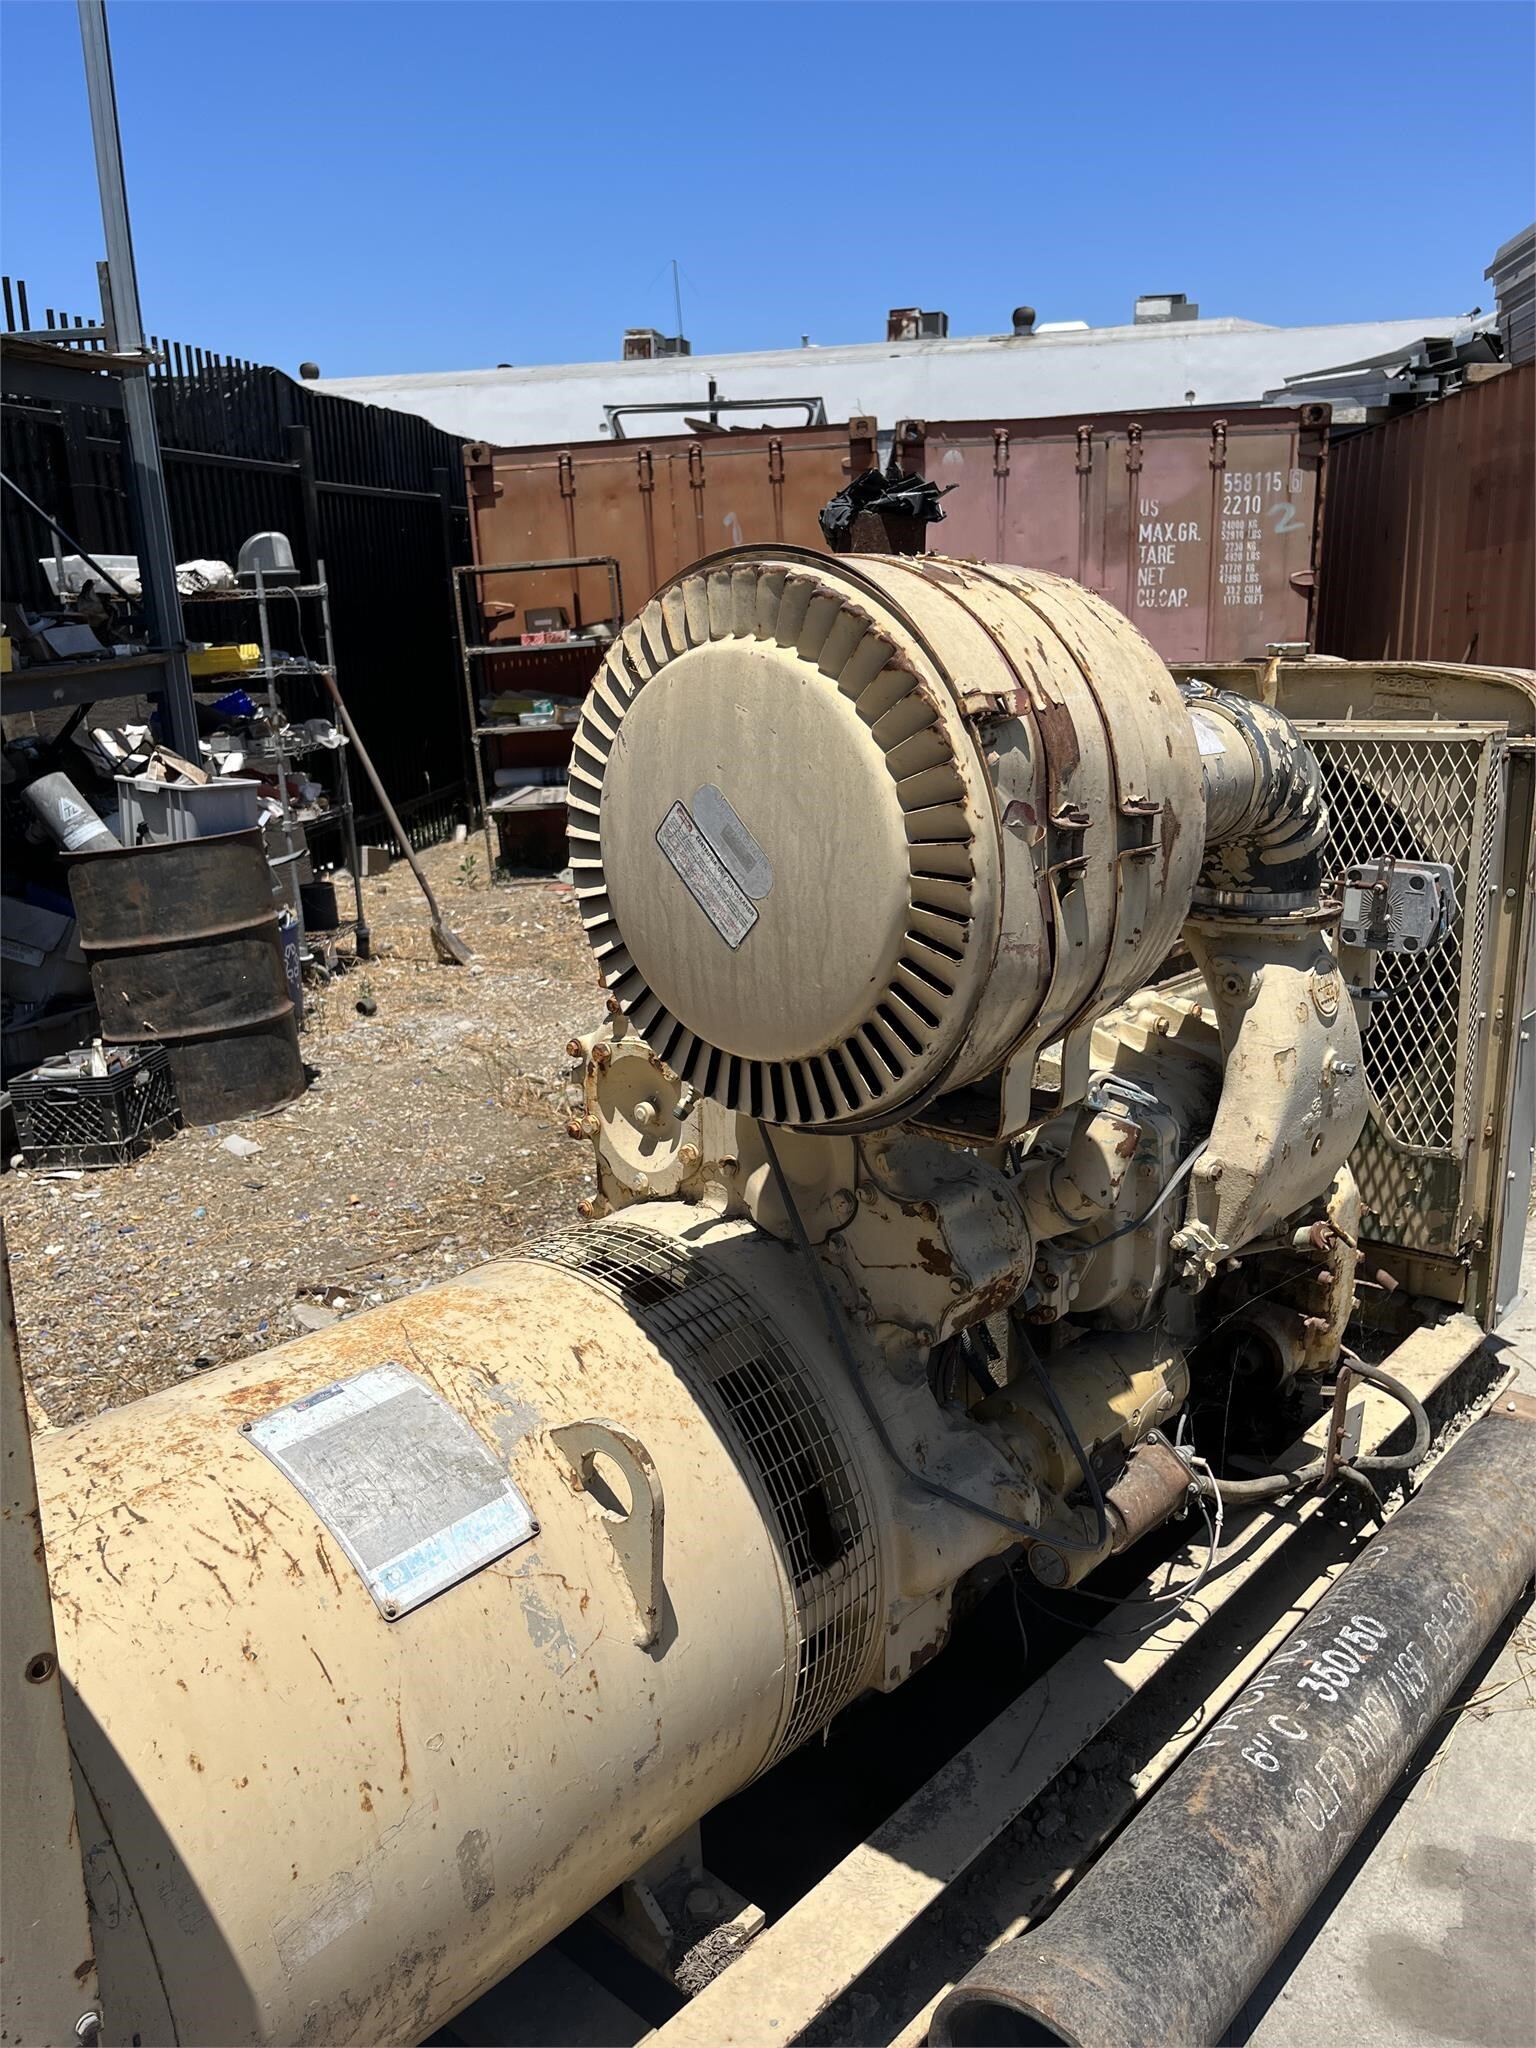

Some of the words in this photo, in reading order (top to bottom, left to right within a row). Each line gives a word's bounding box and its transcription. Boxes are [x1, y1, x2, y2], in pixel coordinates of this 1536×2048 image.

[1223, 472, 1282, 493] 558115
[1139, 498, 1159, 517] US
[1222, 495, 1261, 515] 2210
[1248, 519, 1258, 530] KG
[1267, 502, 1306, 533] 2
[1247, 529, 1262, 540] LBS
[1139, 544, 1176, 565] TARE
[1246, 550, 1261, 561] LBS
[1137, 567, 1165, 587] NET
[1244, 572, 1260, 583] LBS
